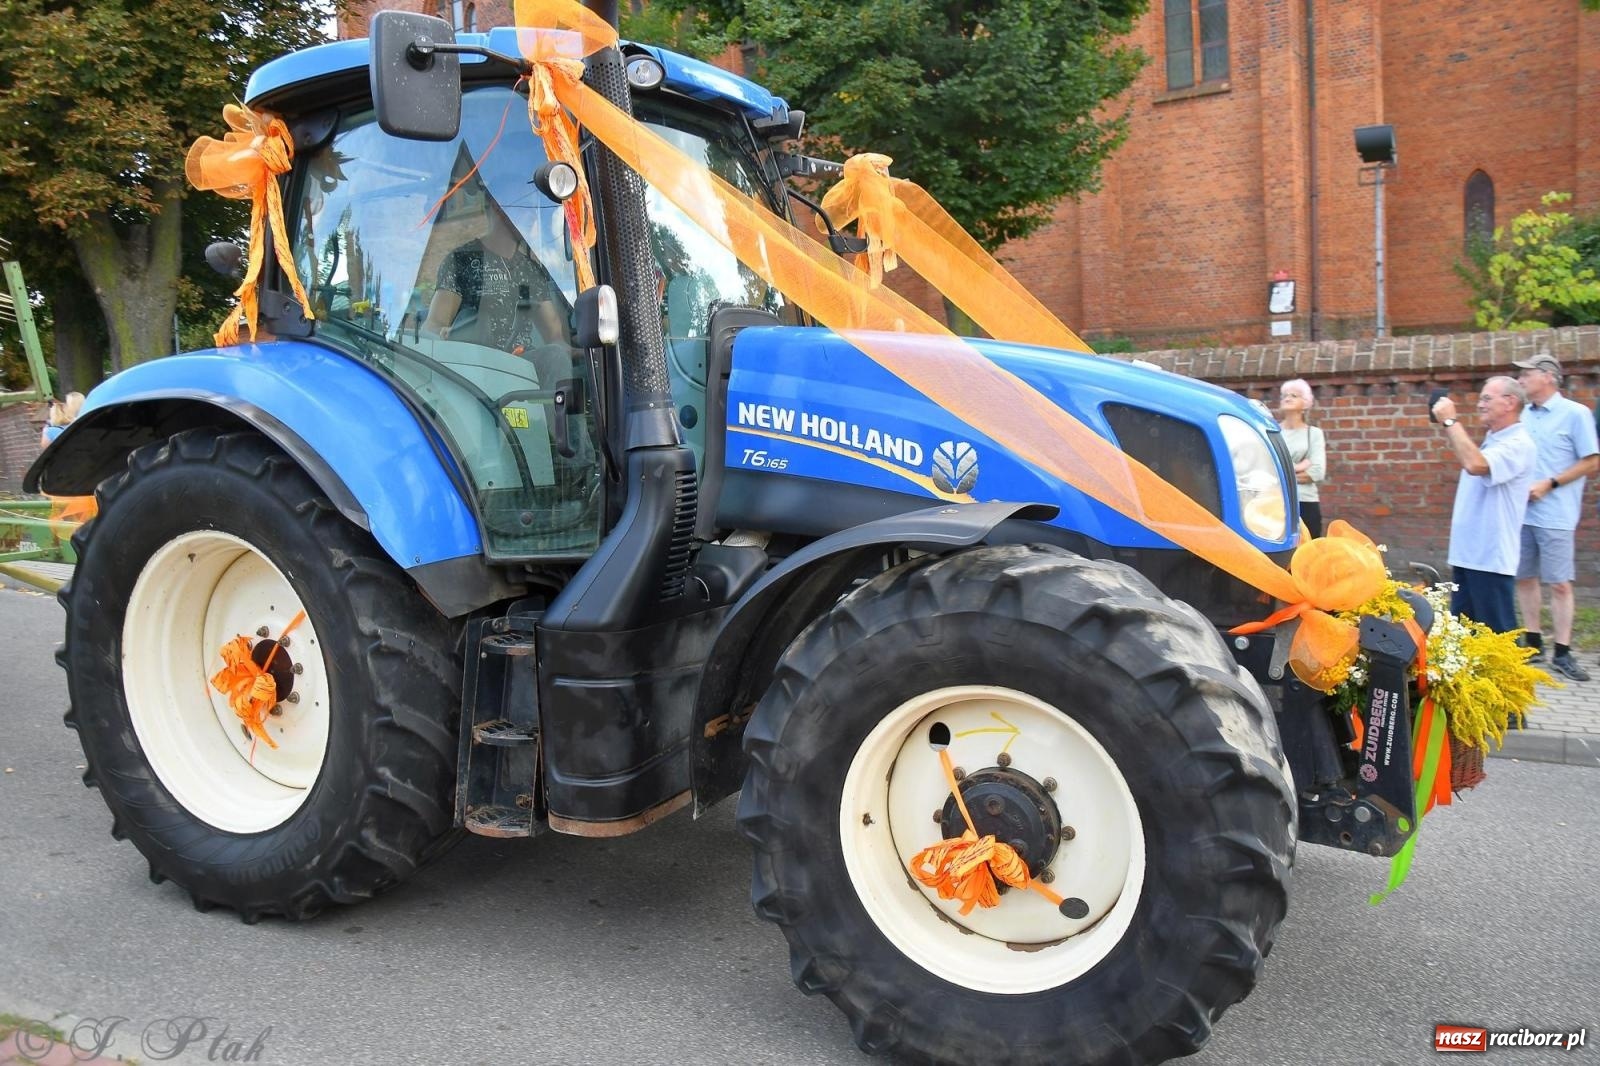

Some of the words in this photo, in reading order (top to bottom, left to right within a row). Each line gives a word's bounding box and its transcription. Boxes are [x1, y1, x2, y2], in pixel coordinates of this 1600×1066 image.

[738, 401, 796, 432] NEW
[801, 412, 924, 467] HOLLAND
[1365, 687, 1385, 762] ZUIDBERG
[1384, 692, 1399, 766] WWW.ZUIDBERG.COM
